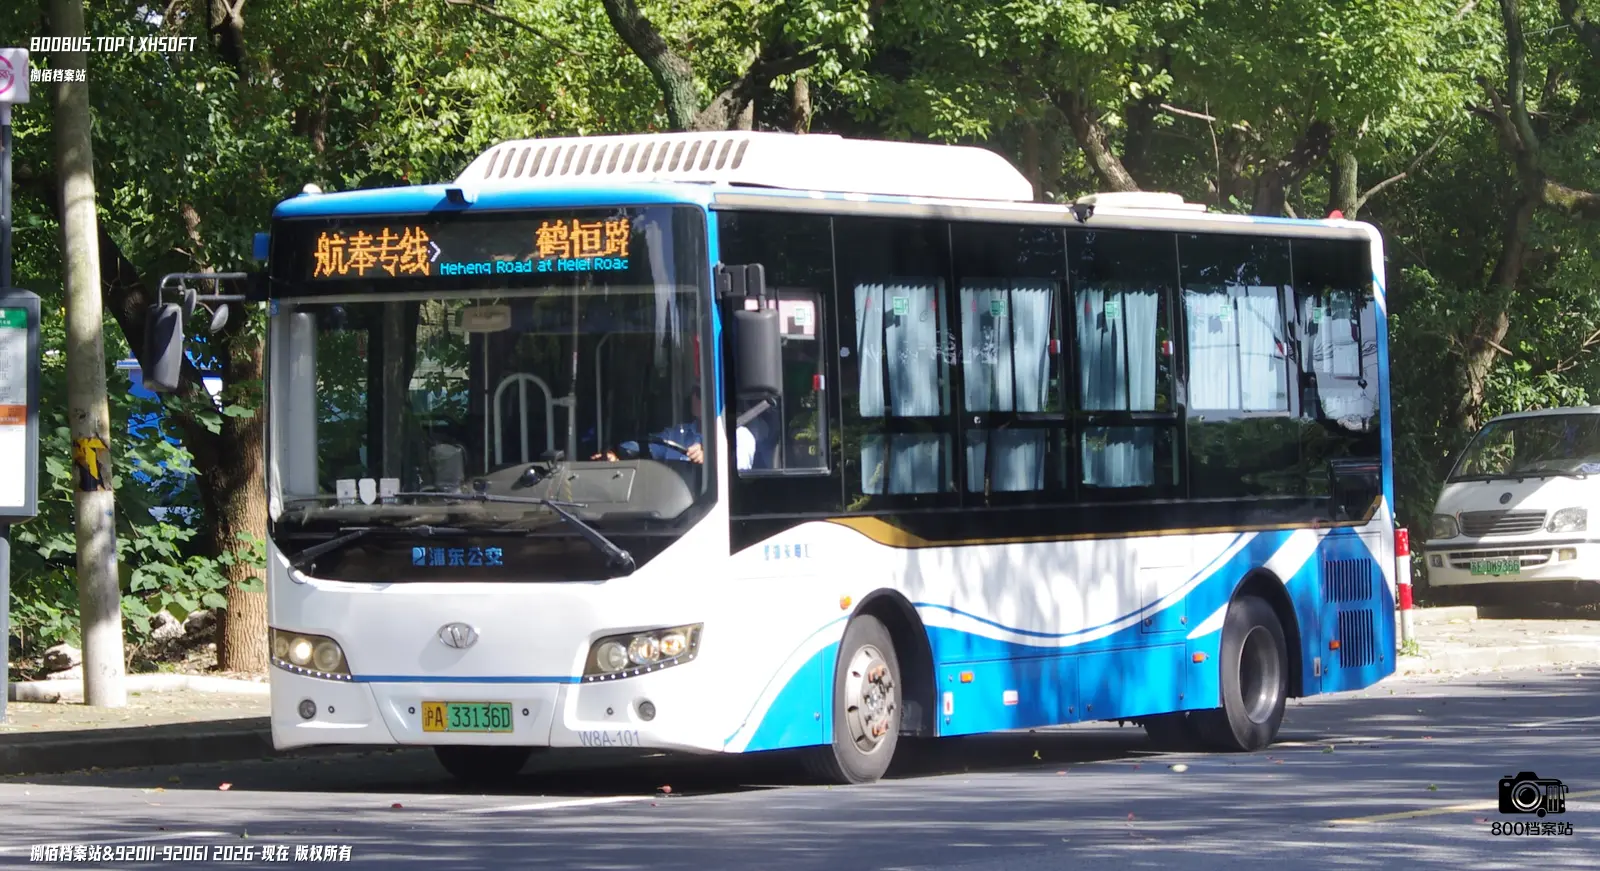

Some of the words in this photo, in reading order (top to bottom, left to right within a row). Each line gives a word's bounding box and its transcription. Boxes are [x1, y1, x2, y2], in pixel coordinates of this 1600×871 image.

[536, 219, 630, 258] 鹤恒路
[314, 227, 430, 277] 航奉专线
[497, 260, 531, 273] Road
[537, 260, 552, 272] at
[428, 547, 503, 567] 浦东公交
[424, 706, 444, 727] 沪A
[452, 707, 511, 728] 33136D
[578, 730, 640, 746] W8A-101
